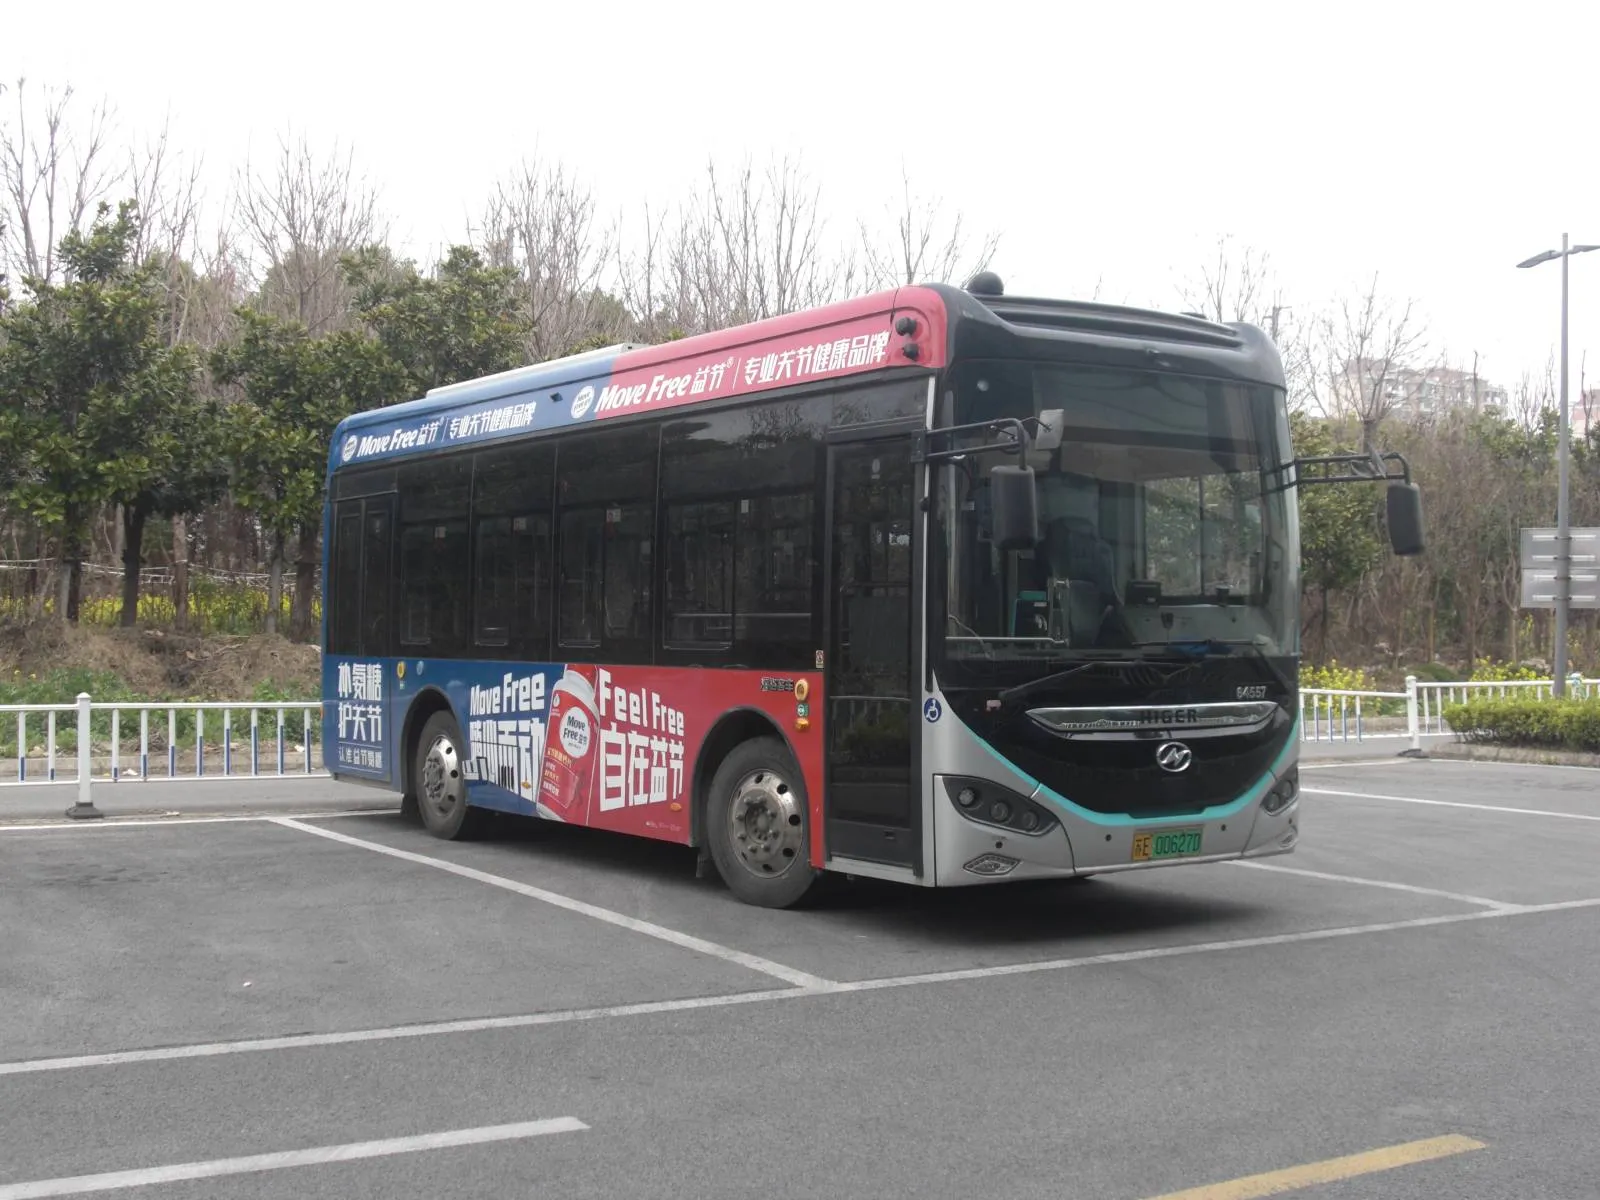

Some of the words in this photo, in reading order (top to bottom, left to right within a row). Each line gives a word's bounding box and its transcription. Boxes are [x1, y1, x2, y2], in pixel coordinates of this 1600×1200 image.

[744, 330, 891, 385] 专业关节健康品牌
[593, 383, 647, 413] Move
[645, 374, 692, 402] Free
[449, 401, 537, 440] 专业关节健康品牌
[356, 435, 389, 458] Move
[388, 428, 420, 451] Free
[469, 684, 501, 716] Move
[503, 672, 545, 713] Free
[599, 667, 648, 727] Feel
[651, 691, 684, 737] Free
[338, 702, 382, 742] 护关节
[563, 727, 579, 741] Free
[566, 715, 586, 732] Move
[1140, 708, 1198, 725] HIGER
[599, 721, 685, 812] 自在益节
